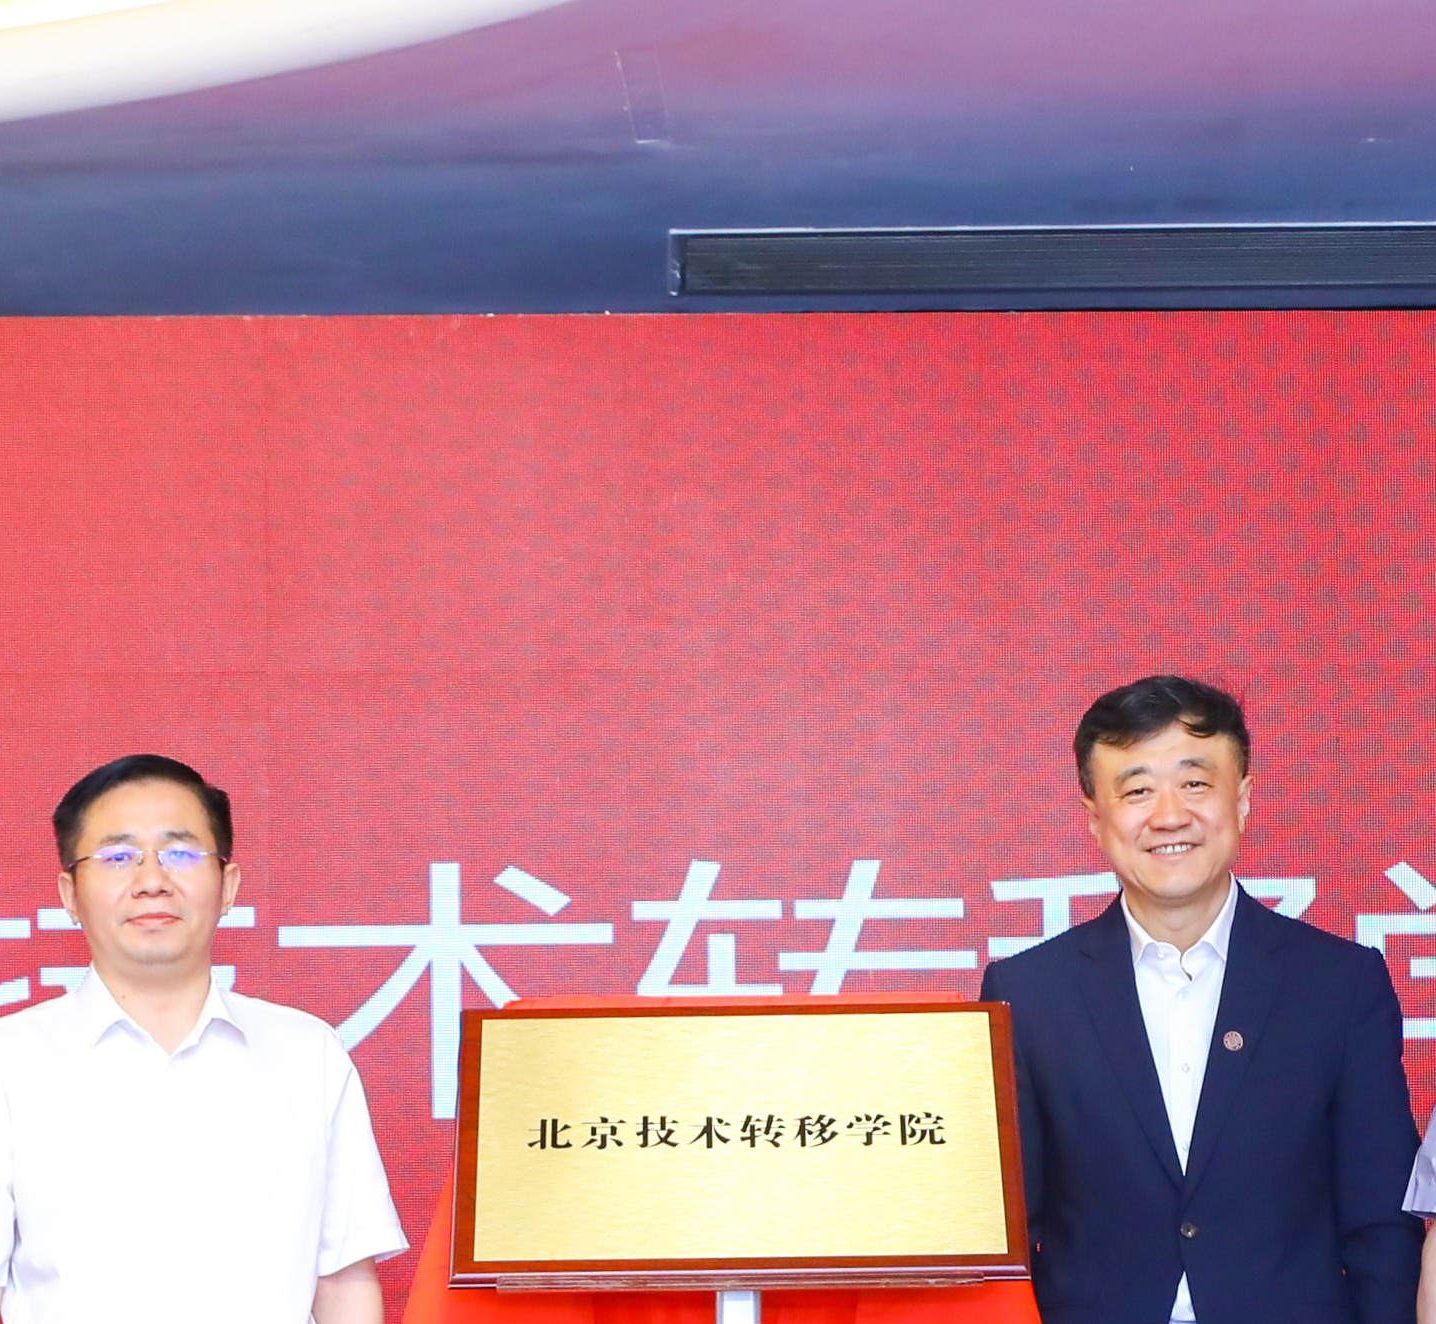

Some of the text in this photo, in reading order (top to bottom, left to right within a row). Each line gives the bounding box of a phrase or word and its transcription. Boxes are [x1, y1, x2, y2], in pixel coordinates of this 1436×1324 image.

[526, 1111, 947, 1151] 北京技术转移学院
